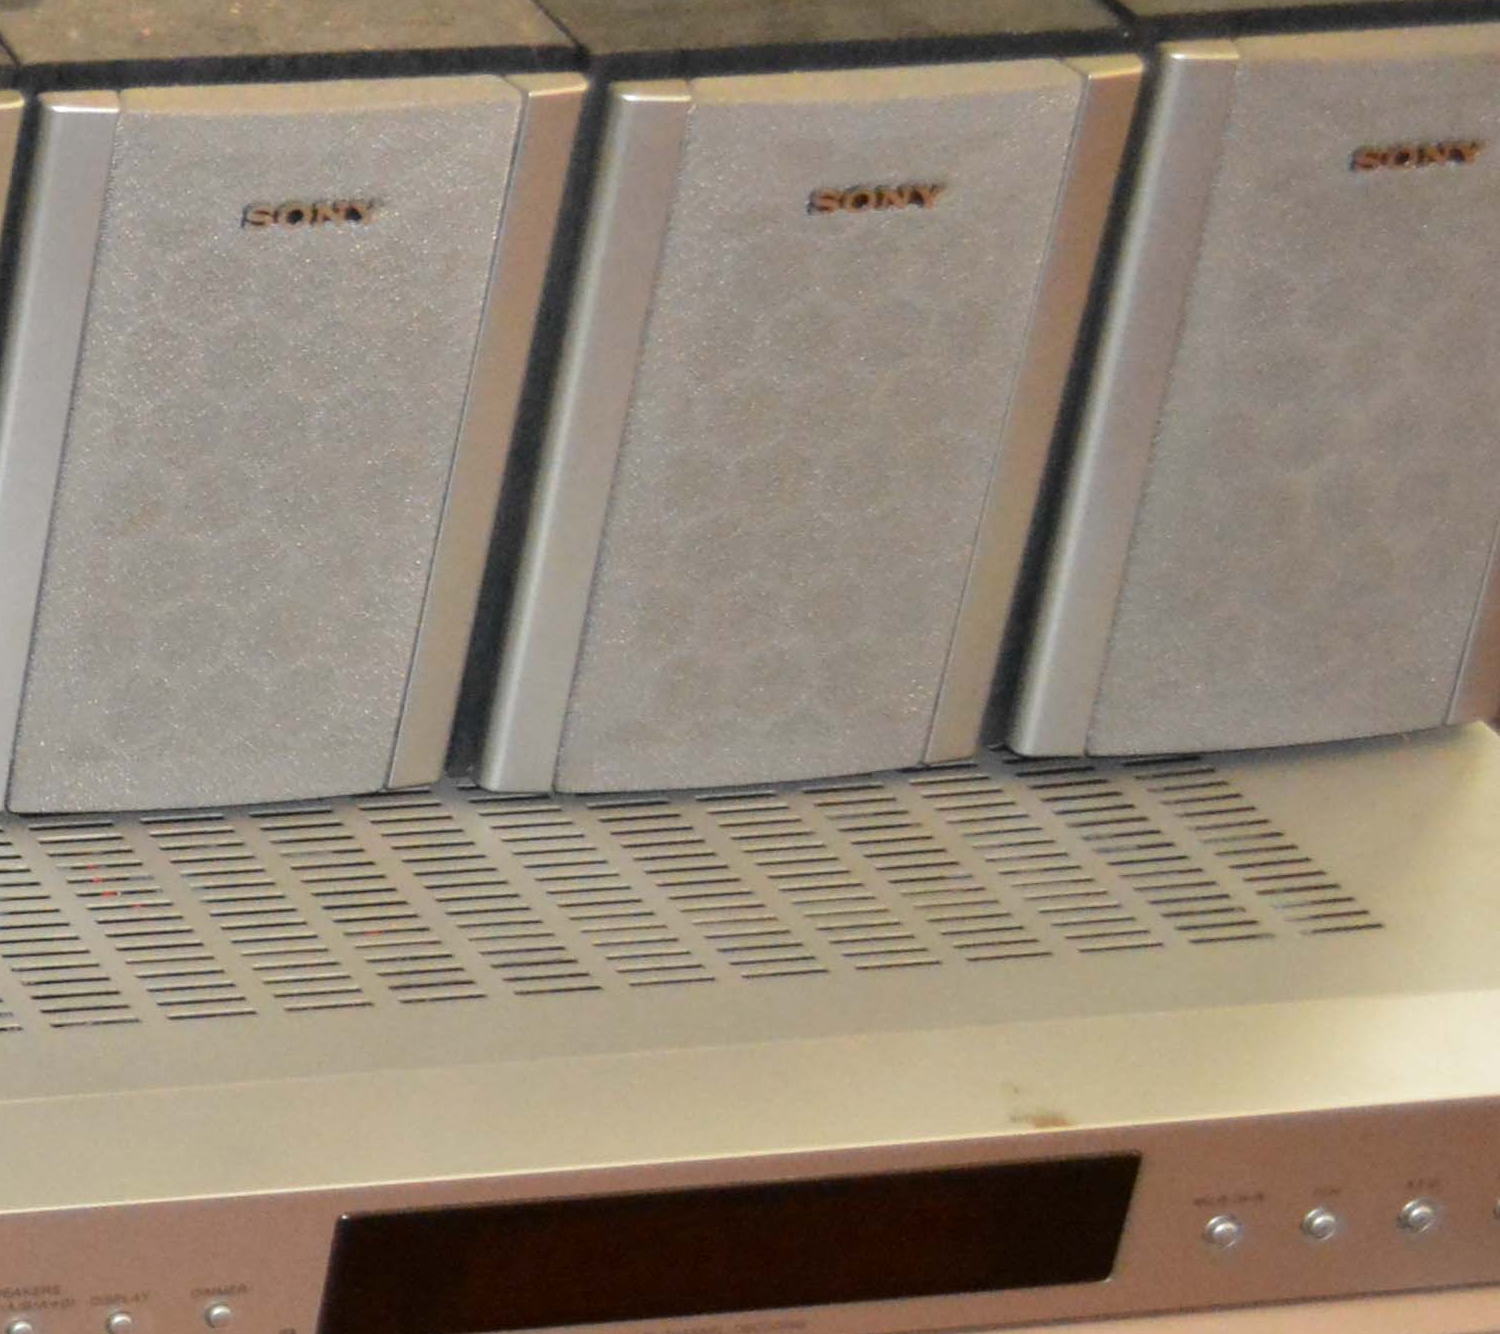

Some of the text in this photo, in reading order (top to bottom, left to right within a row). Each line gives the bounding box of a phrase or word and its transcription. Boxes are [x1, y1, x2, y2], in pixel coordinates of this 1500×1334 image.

[1349, 140, 1485, 172] SONY
[241, 199, 382, 228] SONY
[806, 184, 948, 215] SONY
